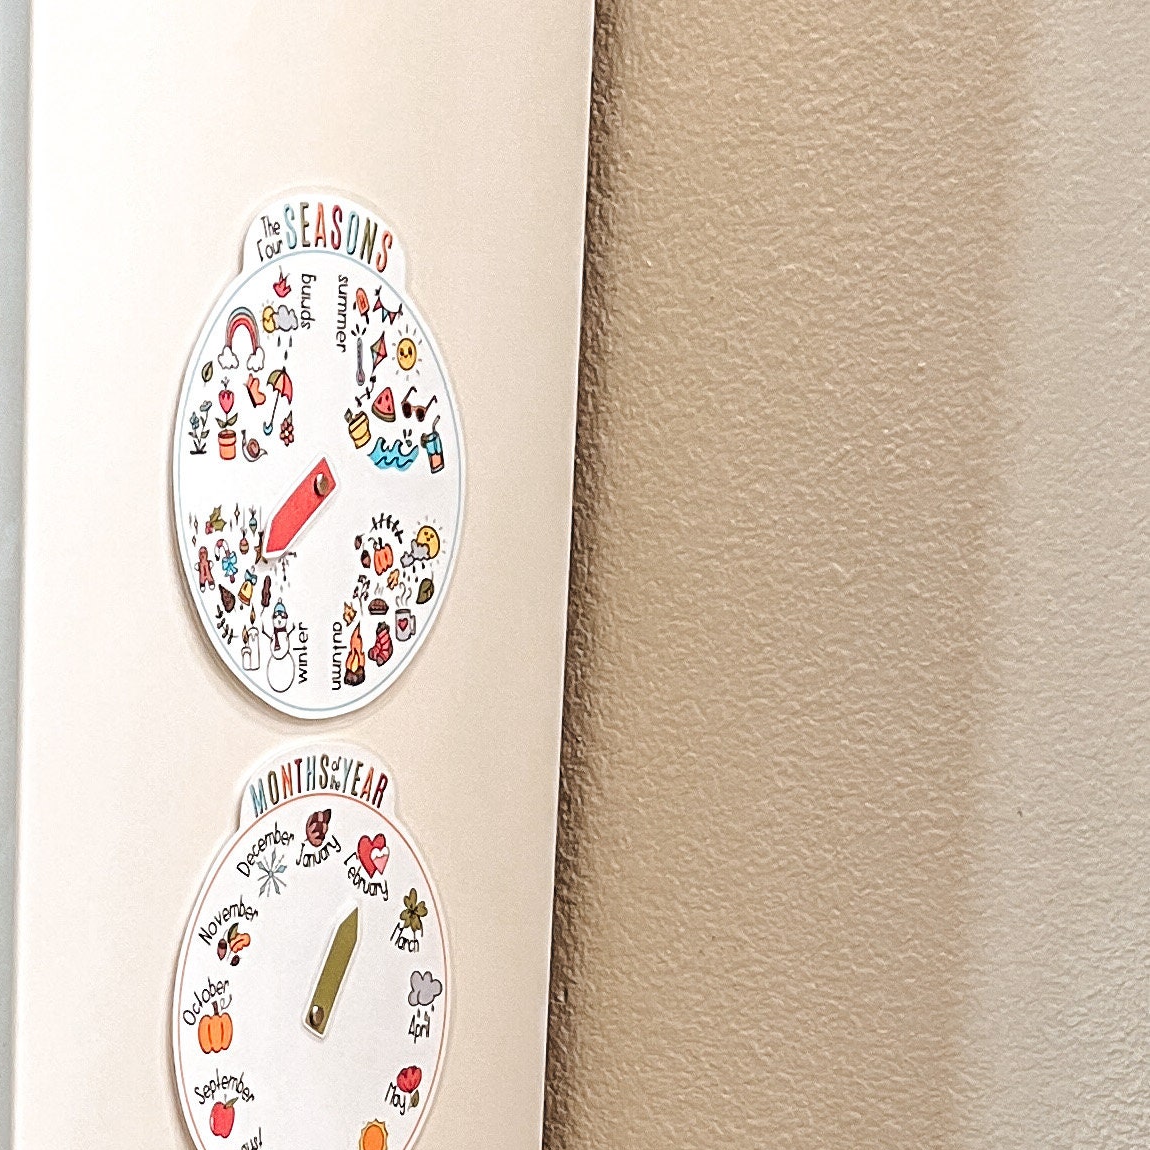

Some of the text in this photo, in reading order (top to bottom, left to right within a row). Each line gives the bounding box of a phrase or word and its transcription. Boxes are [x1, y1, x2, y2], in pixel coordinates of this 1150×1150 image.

[257, 215, 284, 262] The Four
[283, 202, 393, 273] SEASONS
[300, 274, 316, 330] spring
[335, 275, 349, 353] summer
[293, 621, 309, 684] winter
[331, 621, 347, 690] autumn
[250, 753, 389, 818] MONTHS the YEAR
[237, 821, 295, 878] December
[296, 834, 342, 868] January
[344, 851, 389, 901] February
[198, 895, 258, 946] November
[390, 921, 422, 952] March
[182, 976, 230, 1027] October
[408, 1014, 431, 1044] April
[194, 1068, 255, 1105] September
[385, 1081, 407, 1116] May
